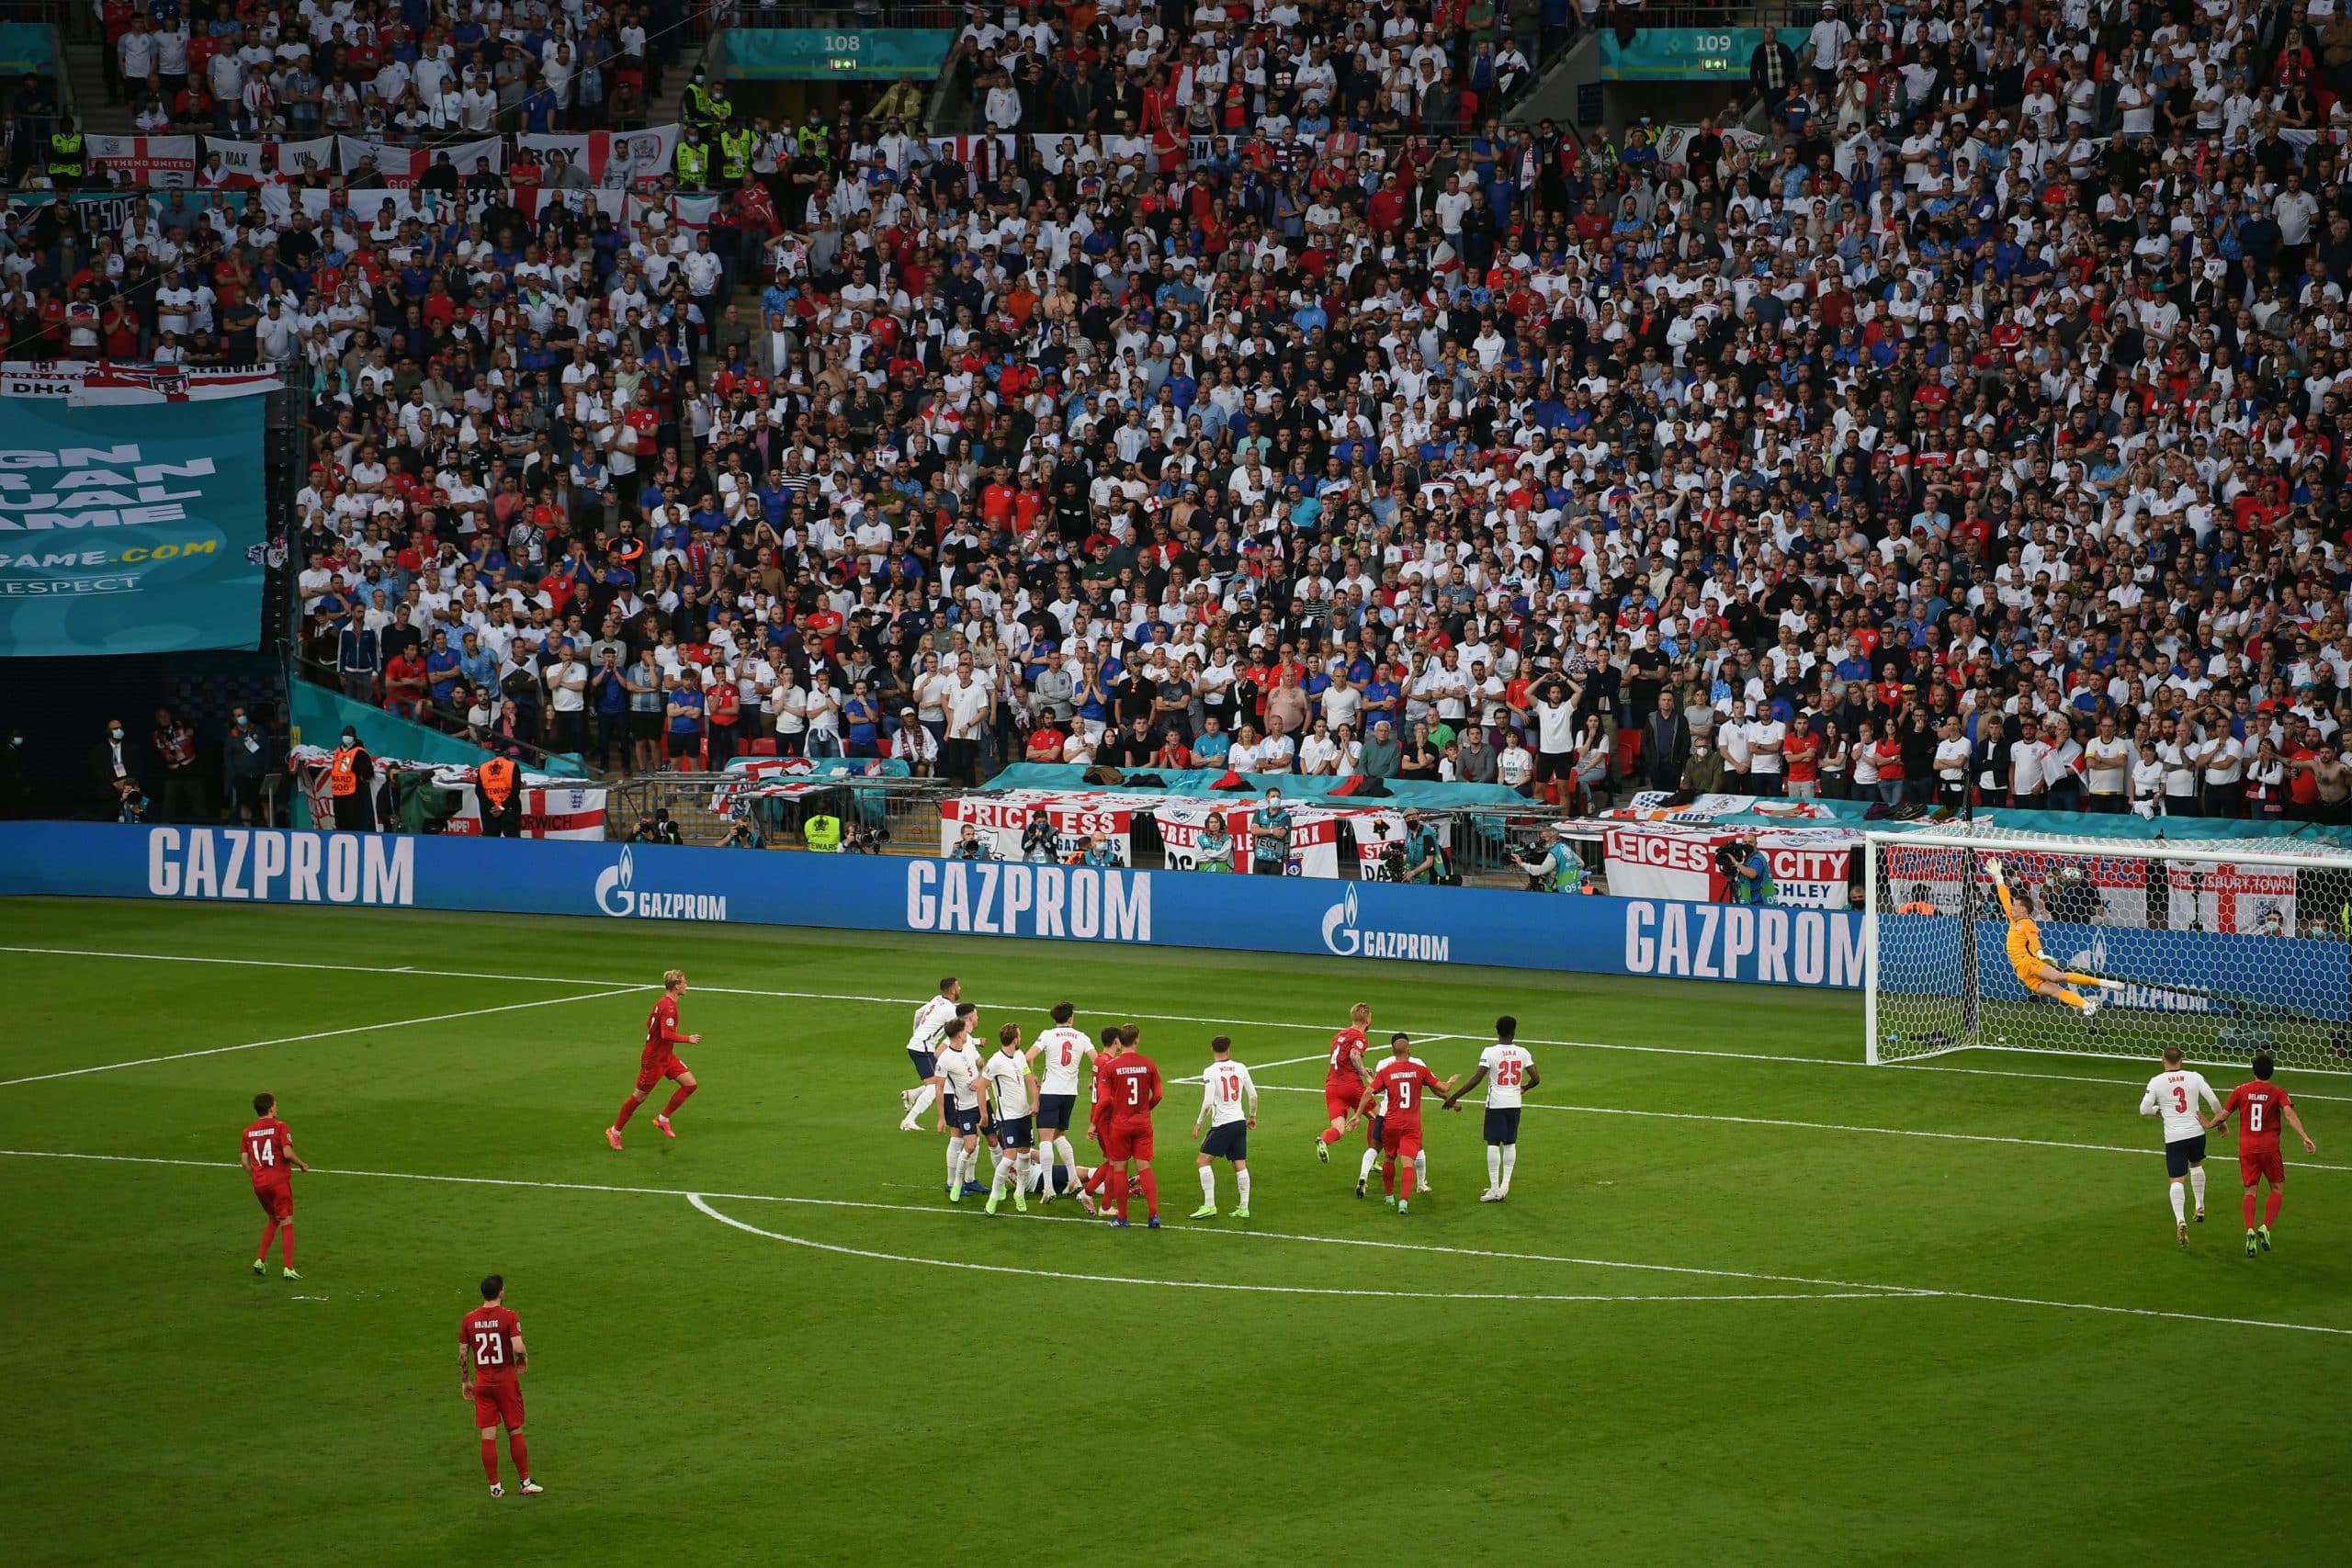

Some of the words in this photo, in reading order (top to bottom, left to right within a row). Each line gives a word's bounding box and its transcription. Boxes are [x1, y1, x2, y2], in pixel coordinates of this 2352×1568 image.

[825, 35, 860, 51] 108
[1696, 35, 1731, 51] 109
[90, 159, 149, 169] SUTHEND
[153, 161, 192, 169] UNITED
[226, 151, 248, 168] MAX
[387, 179, 420, 189] GOS
[1, 371, 42, 379] AND
[13, 383, 73, 394] DH4
[0, 444, 141, 468] GN
[51, 457, 217, 490] AN
[0, 485, 203, 511] UAL
[0, 576, 140, 594] ESPECT
[1057, 839, 1121, 852] GAZRS
[1157, 821, 1204, 847] CREW
[148, 827, 414, 906] GAZPROM
[1607, 829, 1770, 873] LEICEST
[1774, 852, 1849, 879] CITY
[907, 860, 1151, 942] GAZPROM
[1773, 883, 1830, 898] SHLEY
[639, 891, 727, 920] GAZPROM
[1363, 931, 1449, 962] GAZPROM
[1625, 901, 1866, 987] GAZPROM
[1061, 1041, 1073, 1066] 6
[967, 1066, 973, 1077] 5
[1498, 1060, 1521, 1086] 25
[2167, 1076, 2185, 1084] SHAW
[1126, 1077, 1138, 1105] 3
[1220, 1075, 1239, 1102] 19
[1398, 1081, 1410, 1110] 9
[2172, 1086, 2187, 1114] 3
[2250, 1103, 2263, 1132] 8
[252, 1138, 275, 1168] 14
[474, 1332, 504, 1365] 23
